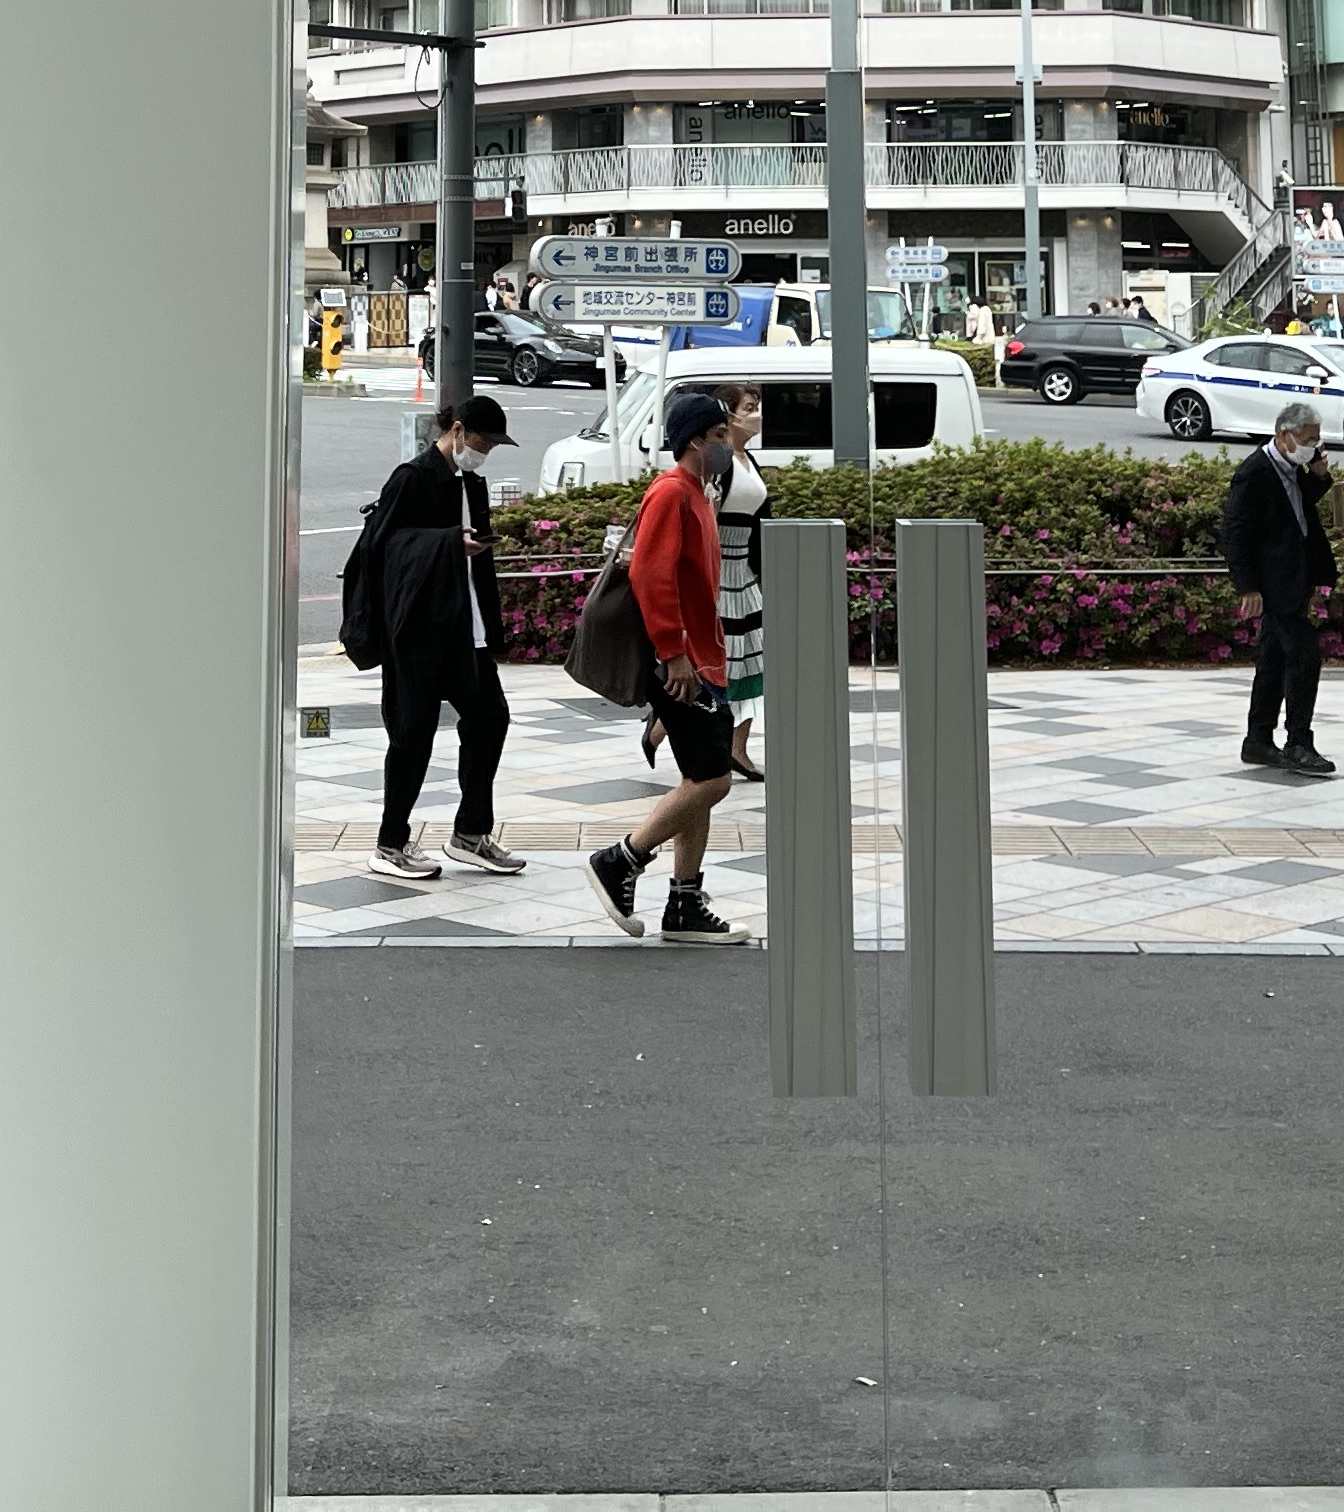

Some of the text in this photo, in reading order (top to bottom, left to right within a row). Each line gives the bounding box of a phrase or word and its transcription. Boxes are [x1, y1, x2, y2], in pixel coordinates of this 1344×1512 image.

[724, 103, 791, 120] anello
[568, 218, 616, 237] aneo
[725, 214, 794, 235] anello
[584, 245, 698, 263] 神宮前出張所
[593, 263, 690, 274] Jingumae Branch Office
[582, 291, 696, 306] 地域交流センター神宮前
[582, 306, 697, 317] Jingumae Community Center
